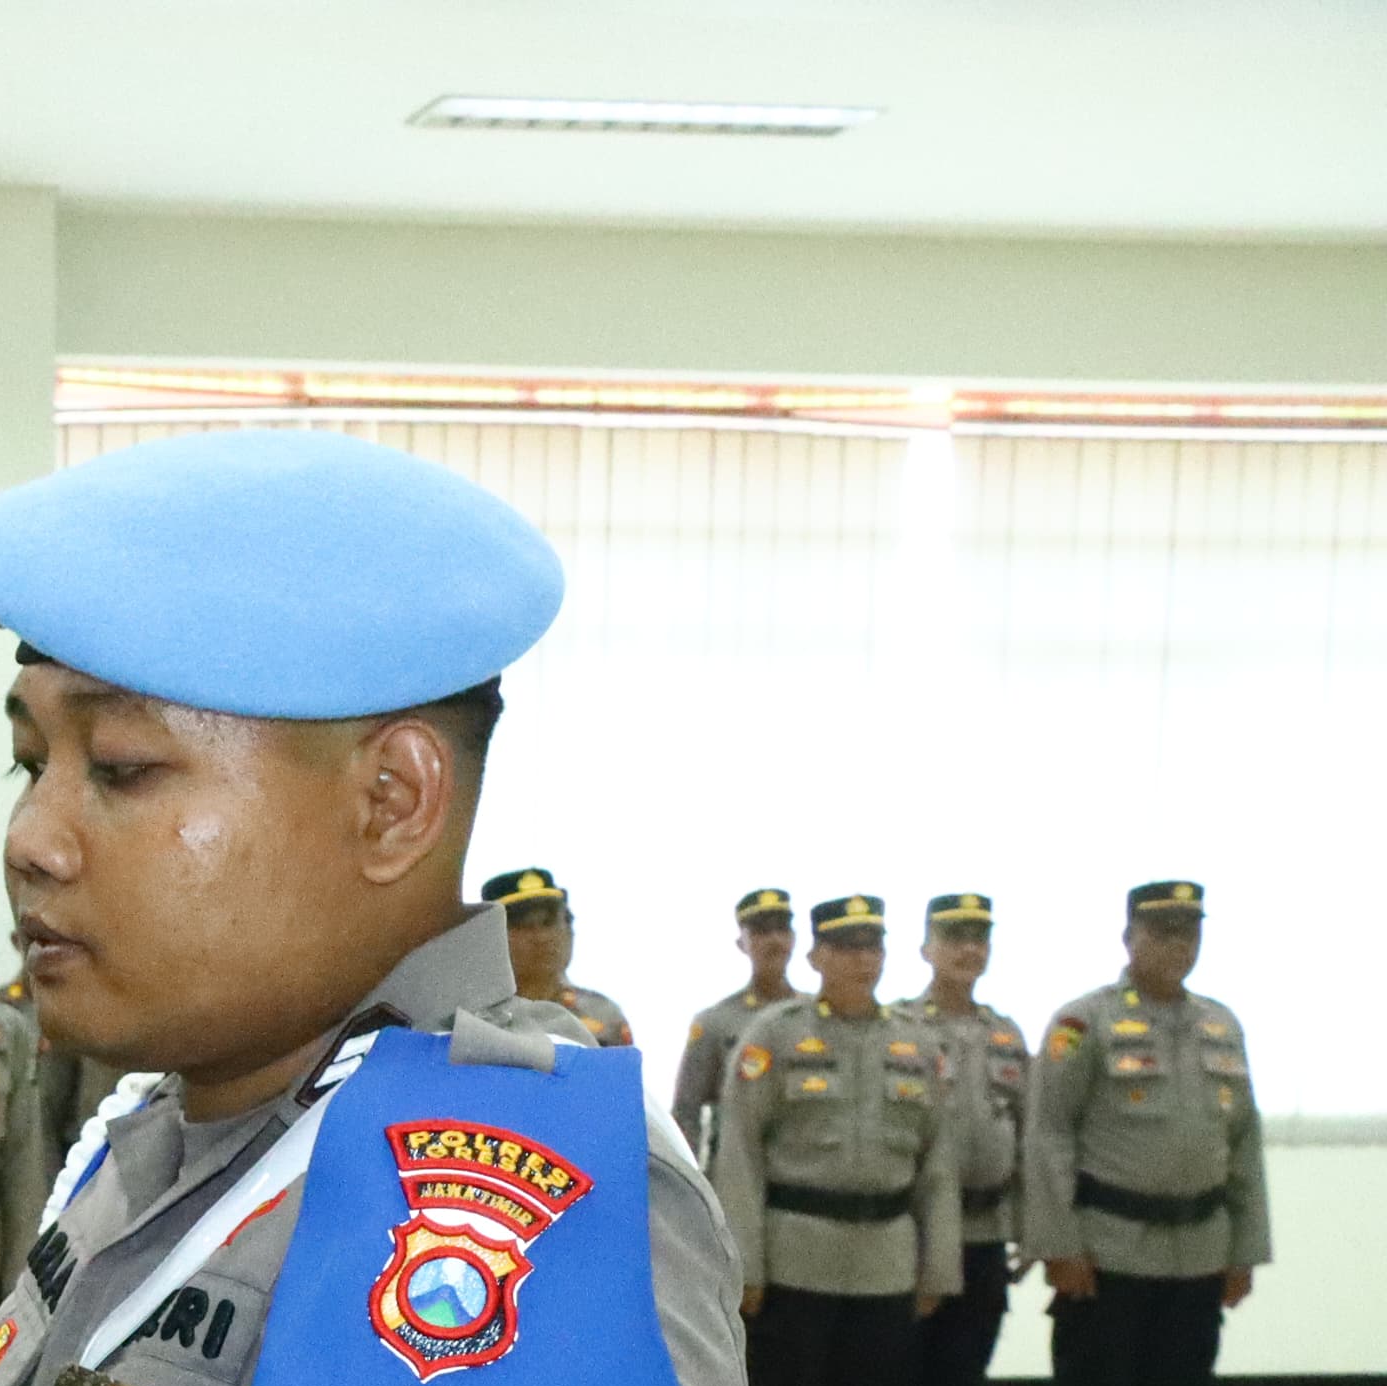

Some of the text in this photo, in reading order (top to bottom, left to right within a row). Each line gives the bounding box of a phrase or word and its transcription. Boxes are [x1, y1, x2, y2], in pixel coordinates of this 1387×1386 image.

[408, 1130, 571, 1189] POLRES
[425, 1144, 550, 1192] GRESIK
[420, 1182, 535, 1227] JAWA TIMUR
